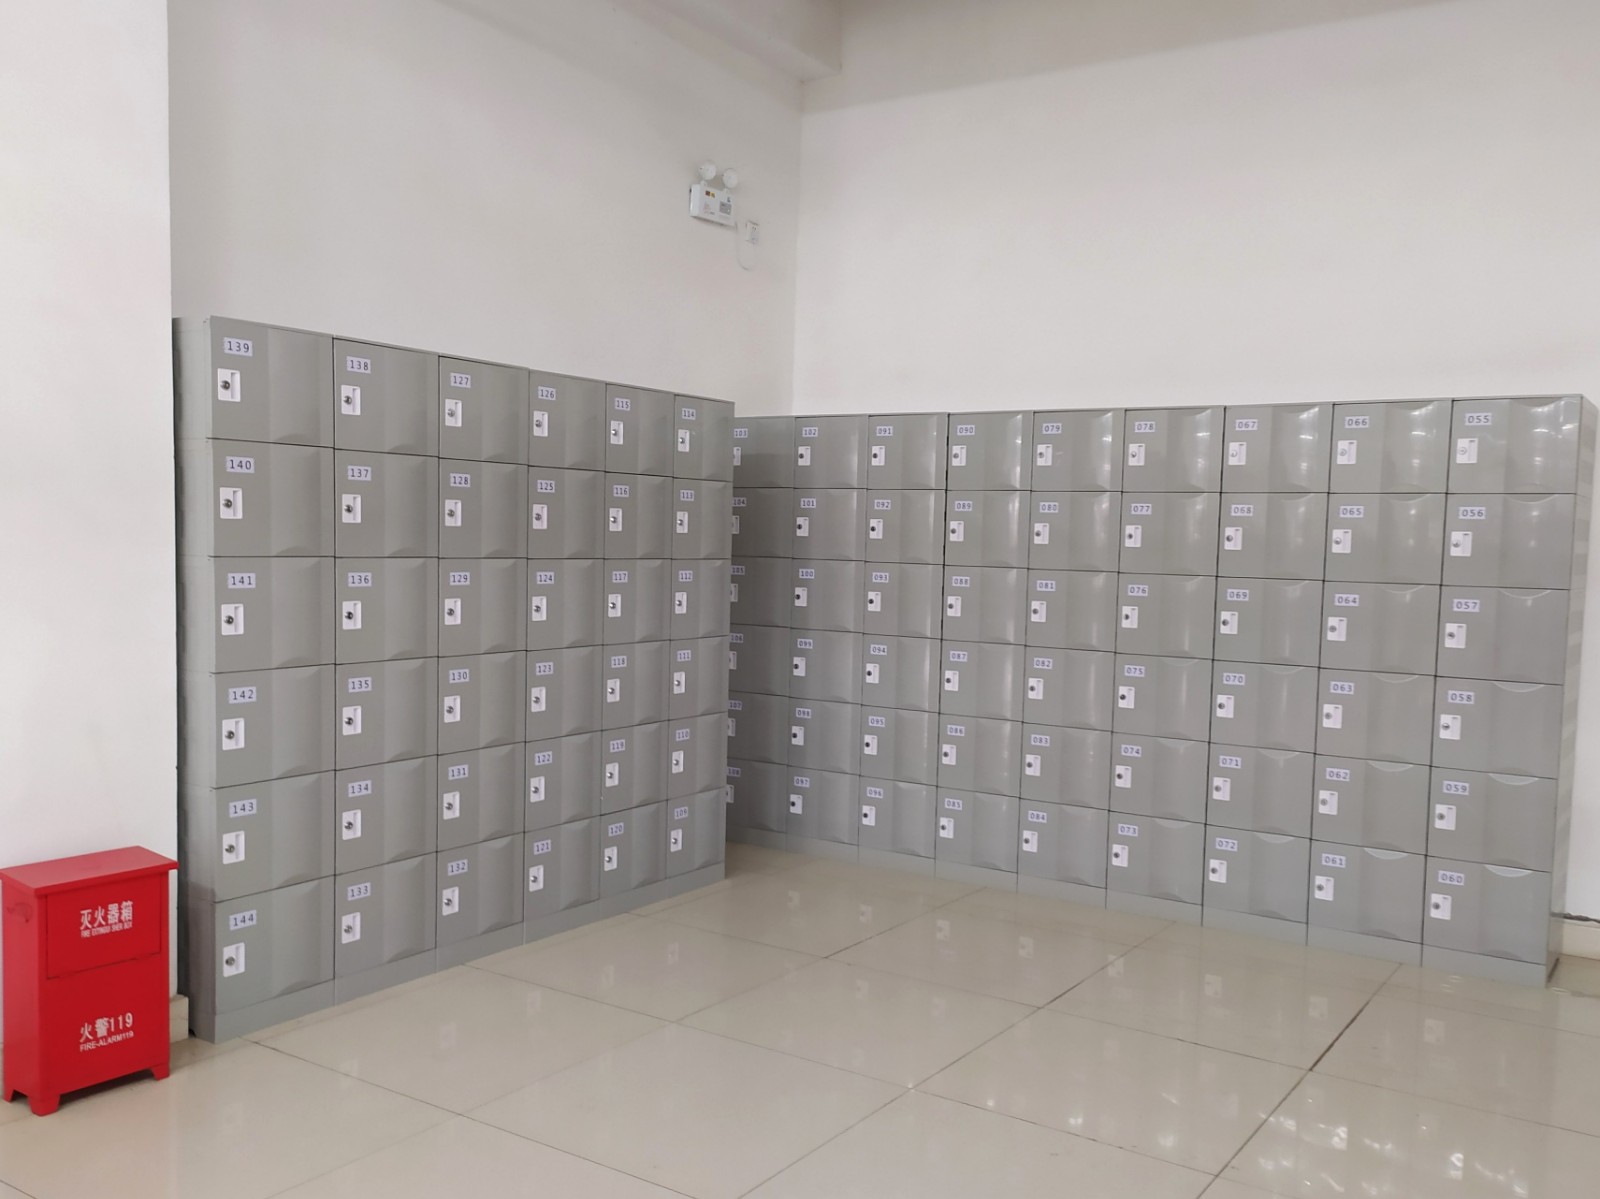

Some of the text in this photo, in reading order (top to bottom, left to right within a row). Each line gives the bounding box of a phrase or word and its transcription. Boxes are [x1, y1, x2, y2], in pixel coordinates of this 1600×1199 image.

[227, 340, 250, 354] 139
[349, 359, 369, 372] 138
[452, 374, 470, 386] 127
[540, 388, 555, 400] 126
[616, 399, 630, 410] 115
[683, 409, 695, 419] 114
[1467, 414, 1490, 424] 055
[1136, 422, 1155, 431] 078
[1237, 420, 1257, 430] 067
[1346, 417, 1368, 427] 066
[803, 428, 817, 437] 102
[877, 427, 892, 436] 091
[958, 426, 974, 435] 090
[1043, 424, 1061, 433] 079
[229, 458, 252, 471] 140
[350, 467, 370, 479] 137
[452, 475, 469, 486] 128
[539, 481, 554, 492] 125
[614, 486, 628, 496] 116
[681, 491, 694, 500] 113
[801, 499, 815, 508] 101
[875, 501, 891, 509] 092
[956, 502, 972, 510] 089
[1040, 503, 1058, 512] 080
[1132, 504, 1151, 513] 077
[1233, 506, 1252, 515] 068
[1341, 507, 1363, 517] 065
[1461, 508, 1485, 518] 056
[231, 575, 253, 586] 141
[350, 574, 370, 585] 136
[451, 573, 469, 584] 129
[538, 573, 553, 583] 124
[613, 572, 627, 582] 117
[680, 572, 692, 581] 112
[873, 573, 888, 582] 093
[1038, 581, 1054, 590] 081
[1129, 585, 1147, 595] 076
[1228, 590, 1248, 600] 069
[1336, 595, 1358, 605] 064
[1455, 600, 1479, 610] 057
[871, 645, 887, 654] 094
[678, 651, 691, 661] 111
[951, 652, 967, 661] 087
[612, 657, 626, 667] 118
[1034, 658, 1052, 668] 082
[537, 663, 552, 674] 123
[1125, 666, 1144, 676] 075
[451, 670, 468, 682] 130
[1224, 674, 1244, 684] 070
[351, 679, 370, 691] 135
[1332, 682, 1353, 693] 063
[232, 688, 254, 701] 142
[1450, 692, 1473, 703] 058
[869, 717, 885, 726] 095
[677, 730, 690, 740] 110
[1032, 735, 1049, 745] 083
[611, 740, 625, 751] 119
[1122, 746, 1141, 756] 074
[536, 753, 551, 764] 122
[1221, 757, 1240, 768] 071
[450, 767, 467, 778] 131
[1327, 769, 1349, 781] 062
[350, 782, 370, 795] 134
[1444, 782, 1468, 794] 059
[232, 801, 255, 815] 143
[1029, 811, 1046, 821] 084
[609, 824, 623, 836] 120
[1119, 825, 1137, 835] 073
[535, 841, 550, 853] 121
[1217, 839, 1236, 850] 072
[1323, 855, 1344, 867] 061
[450, 861, 466, 874] 132
[1440, 872, 1464, 884] 060
[350, 884, 369, 898] 133
[80, 900, 133, 930] 灭火器箱
[233, 913, 255, 927] 144
[80, 1012, 133, 1043] 火警119
